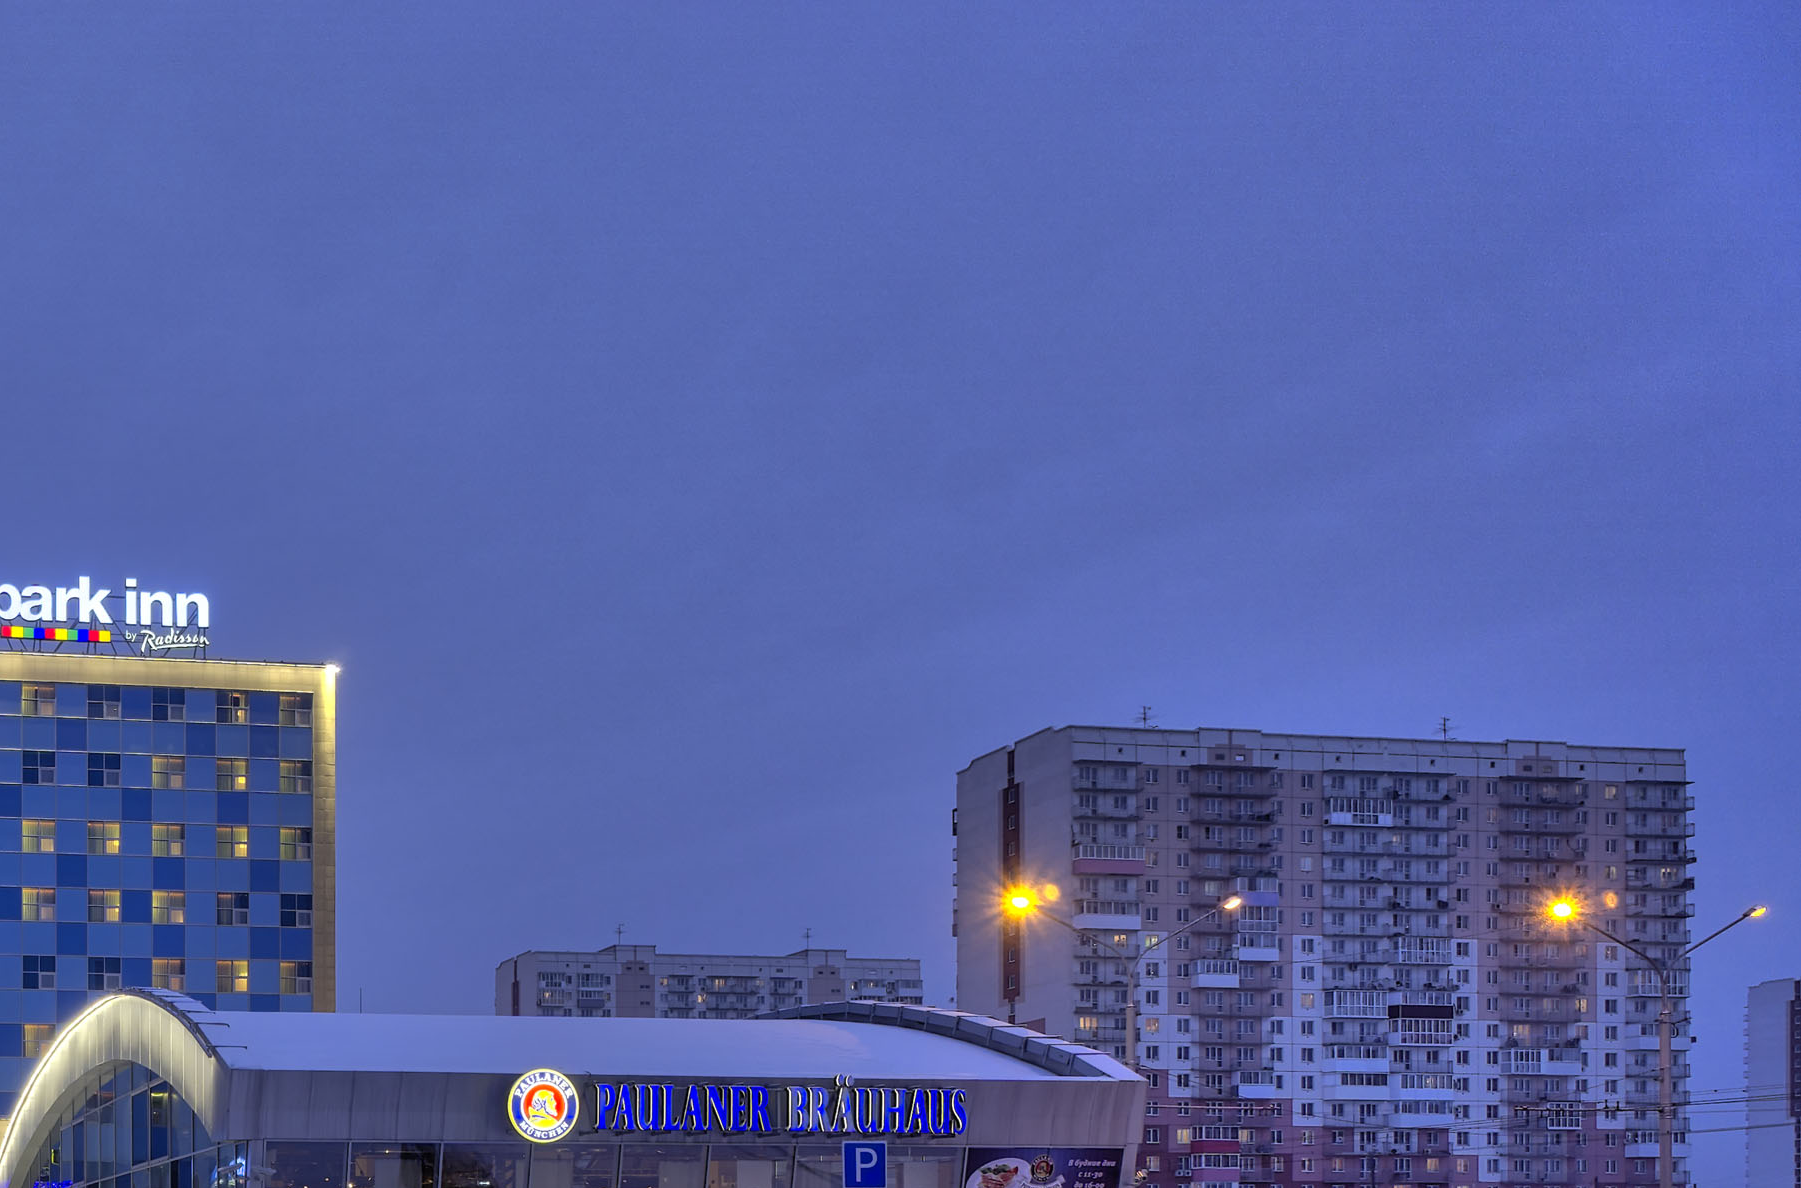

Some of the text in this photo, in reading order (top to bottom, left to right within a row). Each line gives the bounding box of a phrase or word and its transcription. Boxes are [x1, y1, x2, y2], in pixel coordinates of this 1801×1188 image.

[125, 578, 210, 628] inn
[125, 628, 210, 653] by Radisson
[514, 1072, 574, 1099] PAULANER
[594, 1073, 968, 1135] PAULANER BRÄUHAUS
[855, 1147, 878, 1183] P
[1074, 1159, 1101, 1168] будние
